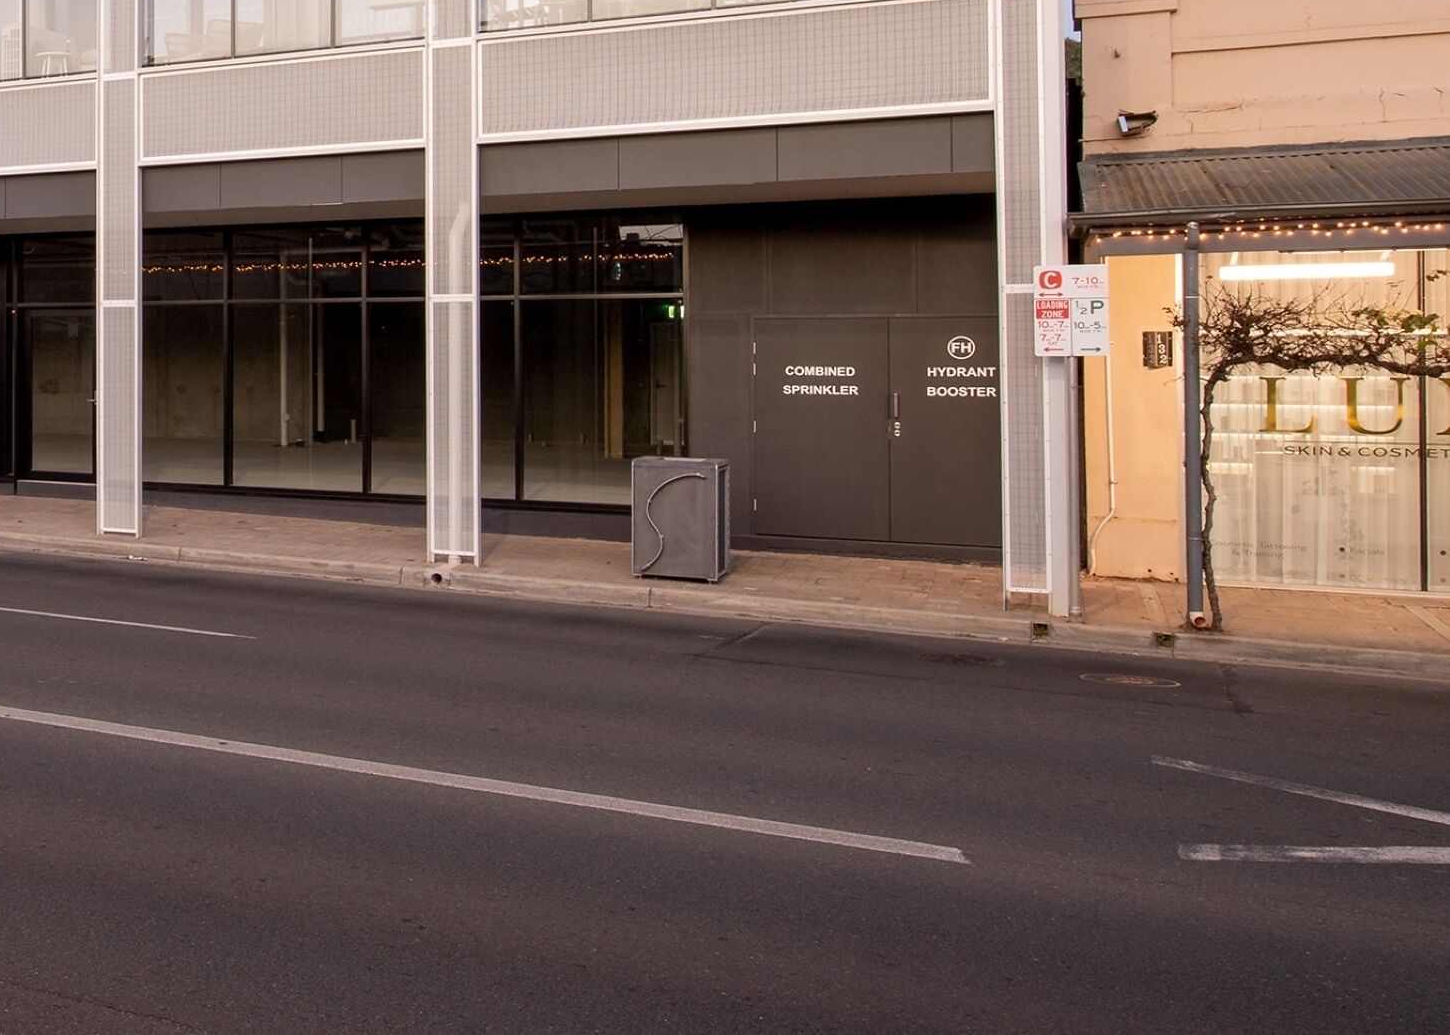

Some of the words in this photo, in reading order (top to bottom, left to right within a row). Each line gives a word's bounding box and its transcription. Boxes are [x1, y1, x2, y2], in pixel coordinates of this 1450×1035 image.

[1043, 271, 1058, 288] C
[1036, 300, 1068, 310] LOADING
[1041, 310, 1065, 318] ZONE
[951, 342, 972, 353] FH
[1156, 334, 1168, 364] 132
[785, 366, 856, 376] COMBINED
[927, 367, 997, 377] HYDRANT
[782, 385, 859, 395] SPRINKLER
[926, 386, 997, 397] BOOSTER
[1259, 376, 1450, 436] LU
[1284, 445, 1333, 457] SKIN
[1337, 447, 1351, 457] &
